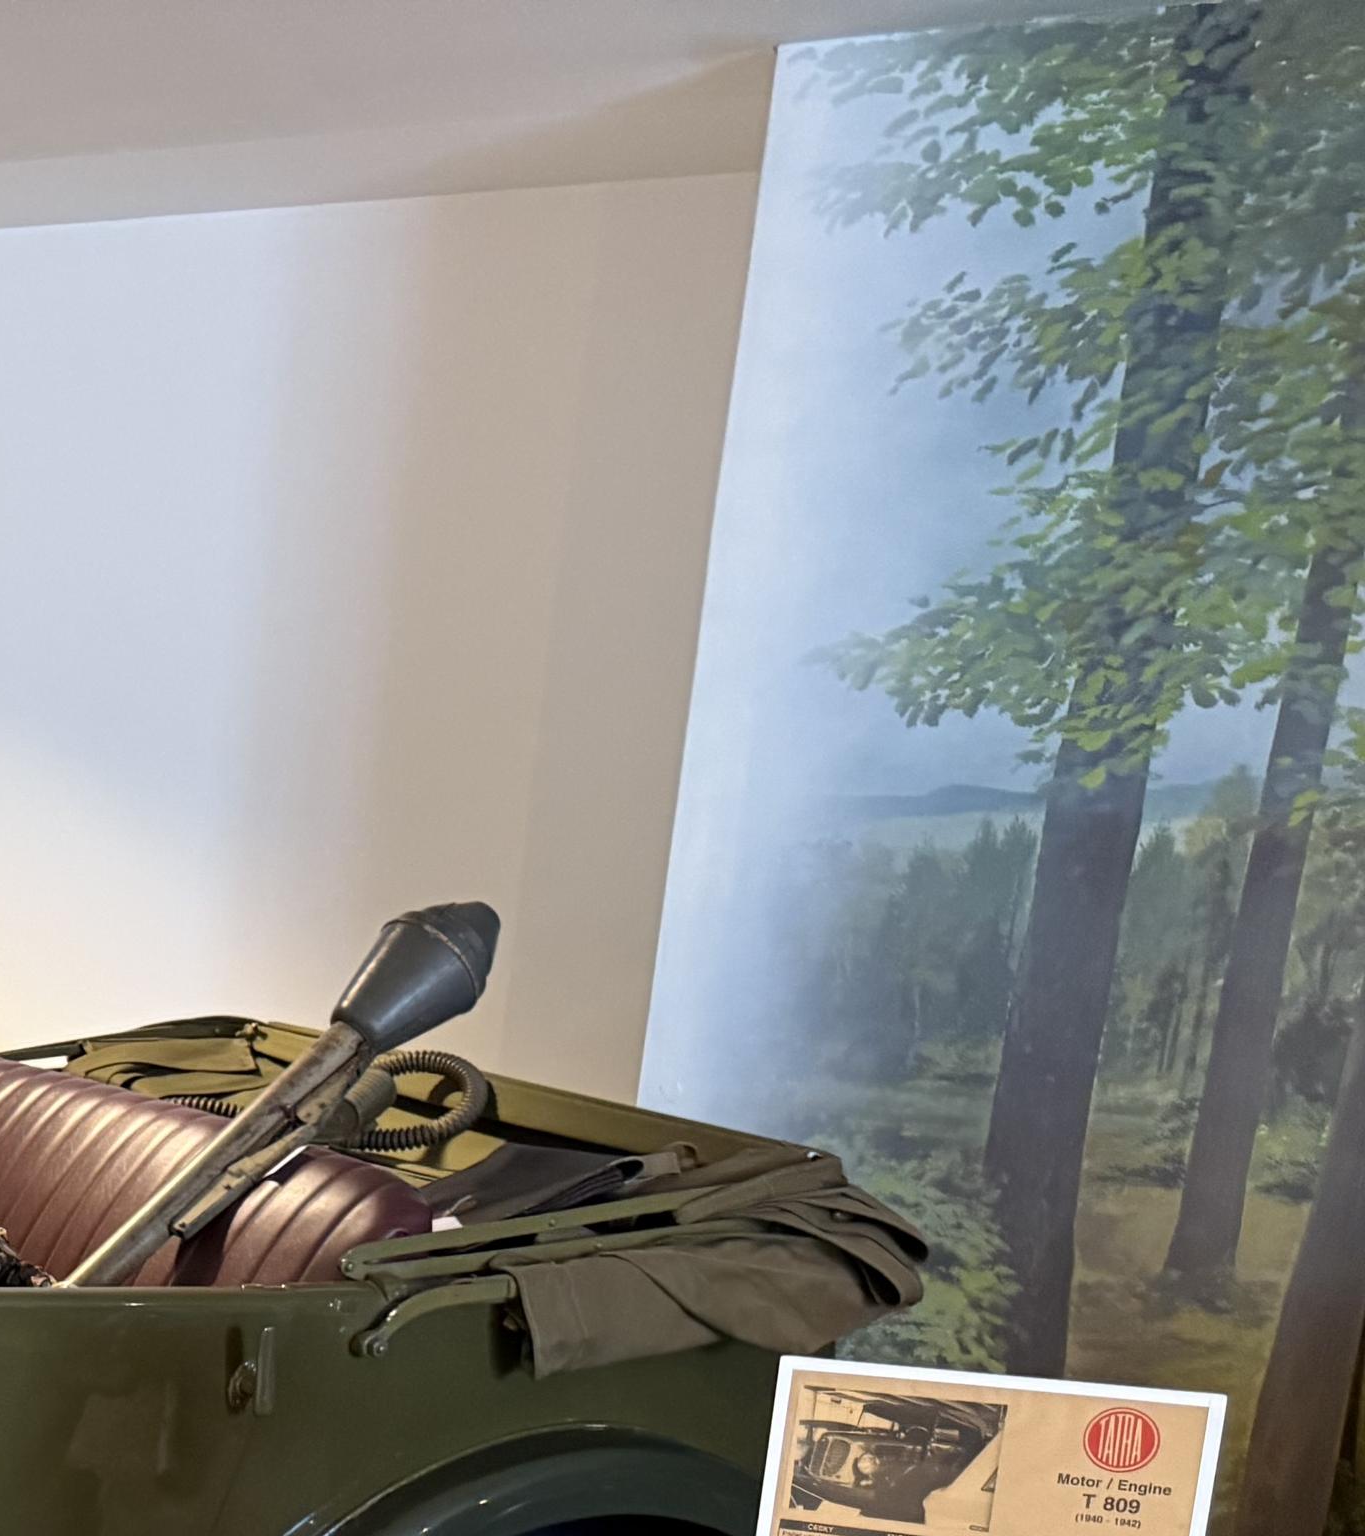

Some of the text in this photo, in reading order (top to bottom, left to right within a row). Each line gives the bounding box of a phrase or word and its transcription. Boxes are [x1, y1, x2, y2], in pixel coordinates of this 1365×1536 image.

[1098, 1414, 1143, 1466] TATRA
[1057, 1472, 1171, 1496] Motor / Engine
[1083, 1494, 1141, 1514] T 809
[1075, 1513, 1103, 1524] (1940
[1115, 1517, 1141, 1529] 1942)
